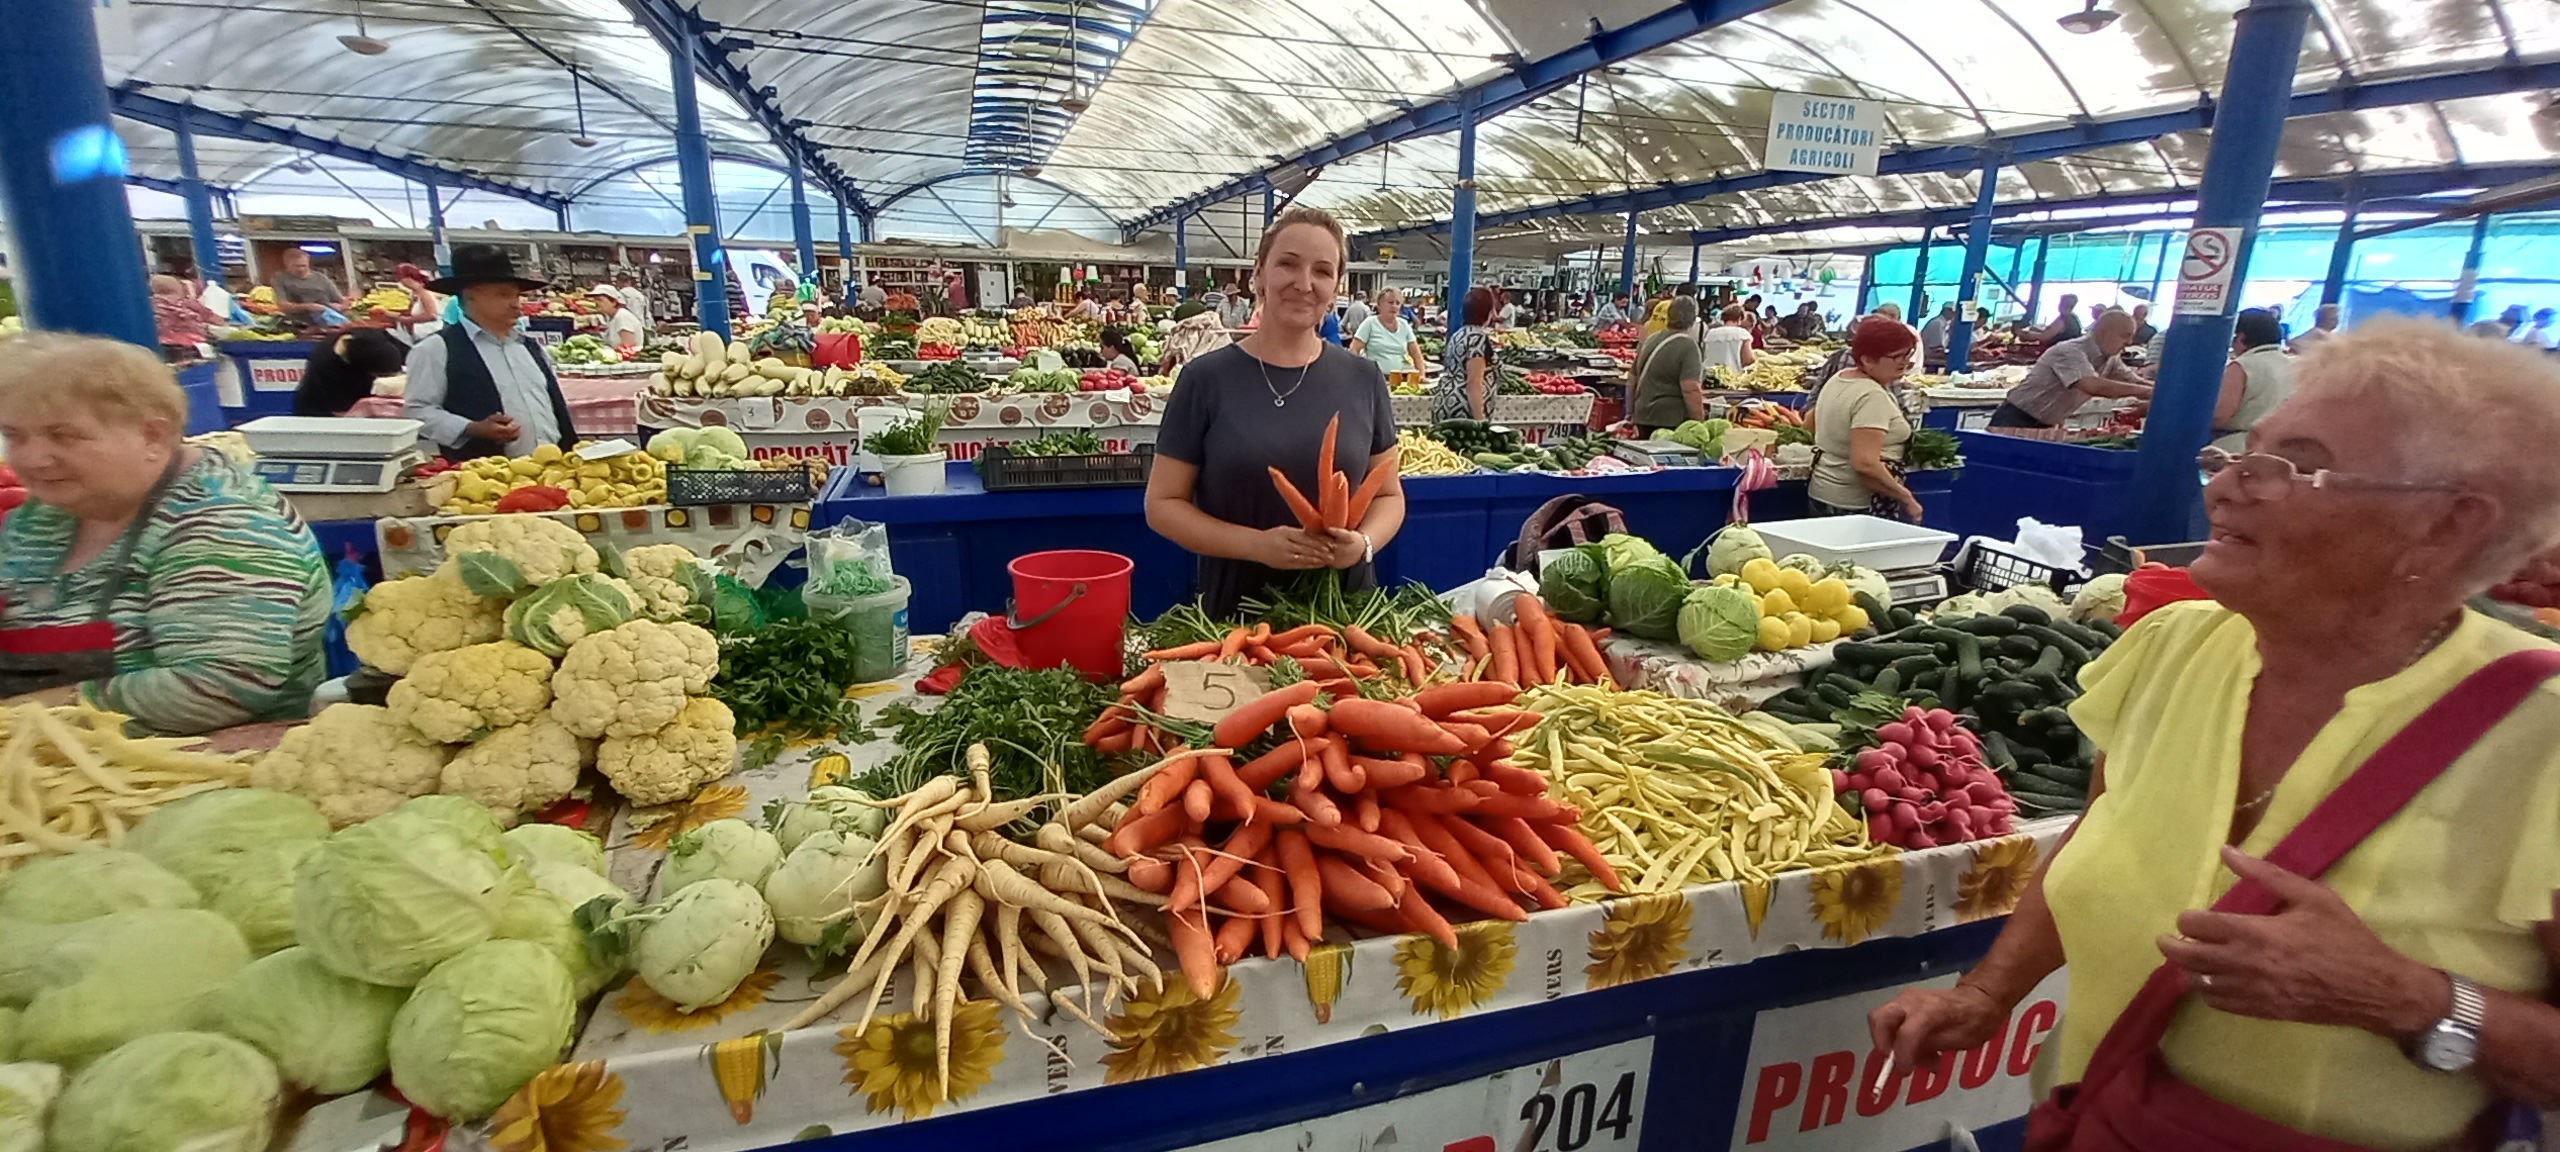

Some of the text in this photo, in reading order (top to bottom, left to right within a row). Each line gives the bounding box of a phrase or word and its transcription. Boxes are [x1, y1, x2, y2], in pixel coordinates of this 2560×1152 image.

[1802, 100, 1856, 121] SECTOR
[1789, 148, 1855, 169] AGRICOLI
[1547, 424, 1569, 438] 249
[1203, 672, 1236, 710] 5
[1519, 1070, 1637, 1152] 204
